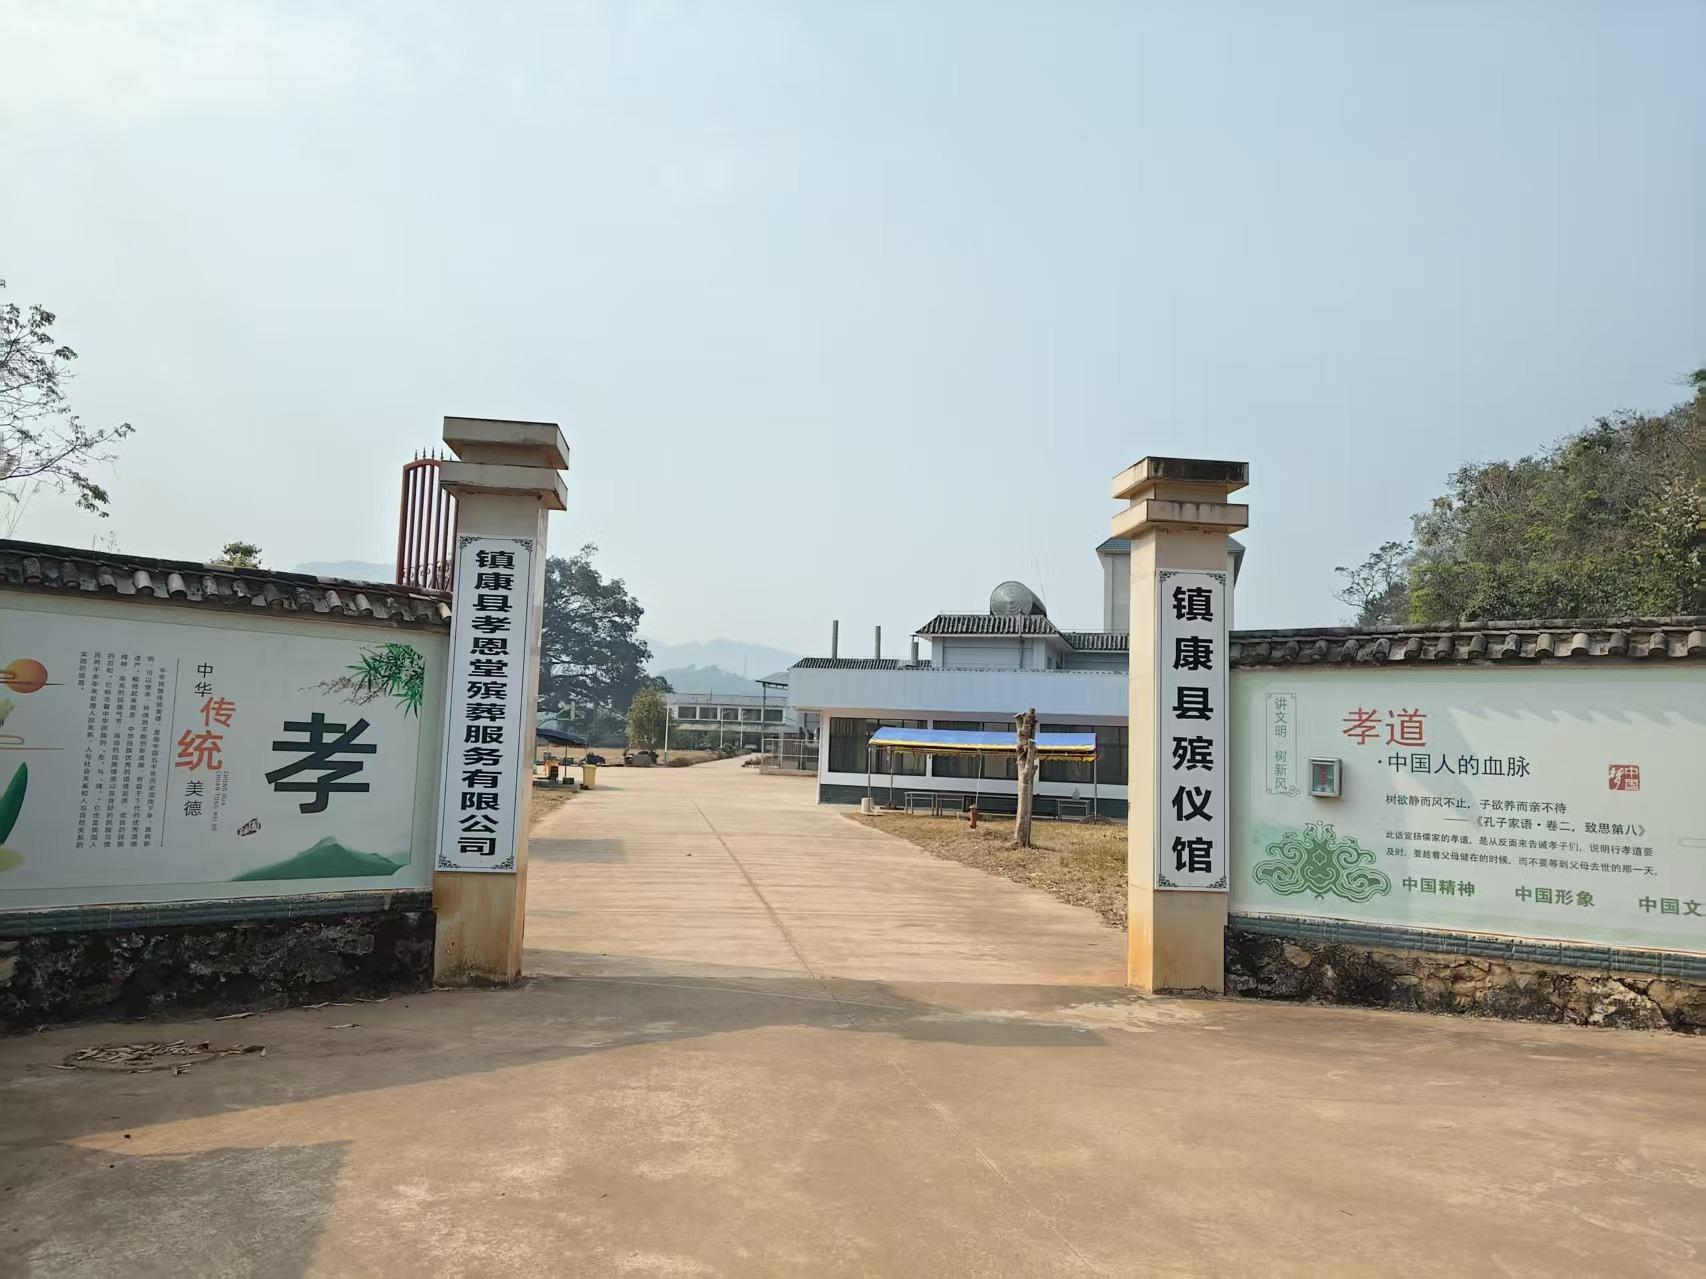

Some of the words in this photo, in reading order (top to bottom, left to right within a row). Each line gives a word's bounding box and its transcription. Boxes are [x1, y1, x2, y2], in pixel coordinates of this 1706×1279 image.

[194, 662, 213, 697] 中华
[457, 549, 516, 857] 镇康县孝恩堂殡葬服务有限公司
[1274, 697, 1287, 738] 讲文明
[175, 696, 236, 771] 传统
[1172, 586, 1213, 873] 镇康县殡仪馆
[1342, 707, 1427, 747] 孝道
[265, 712, 377, 814] 孝
[1274, 750, 1287, 790] 树新风
[184, 780, 203, 817] 美德
[1402, 876, 1475, 897] 中国精神
[1515, 886, 1595, 907] 中国形象
